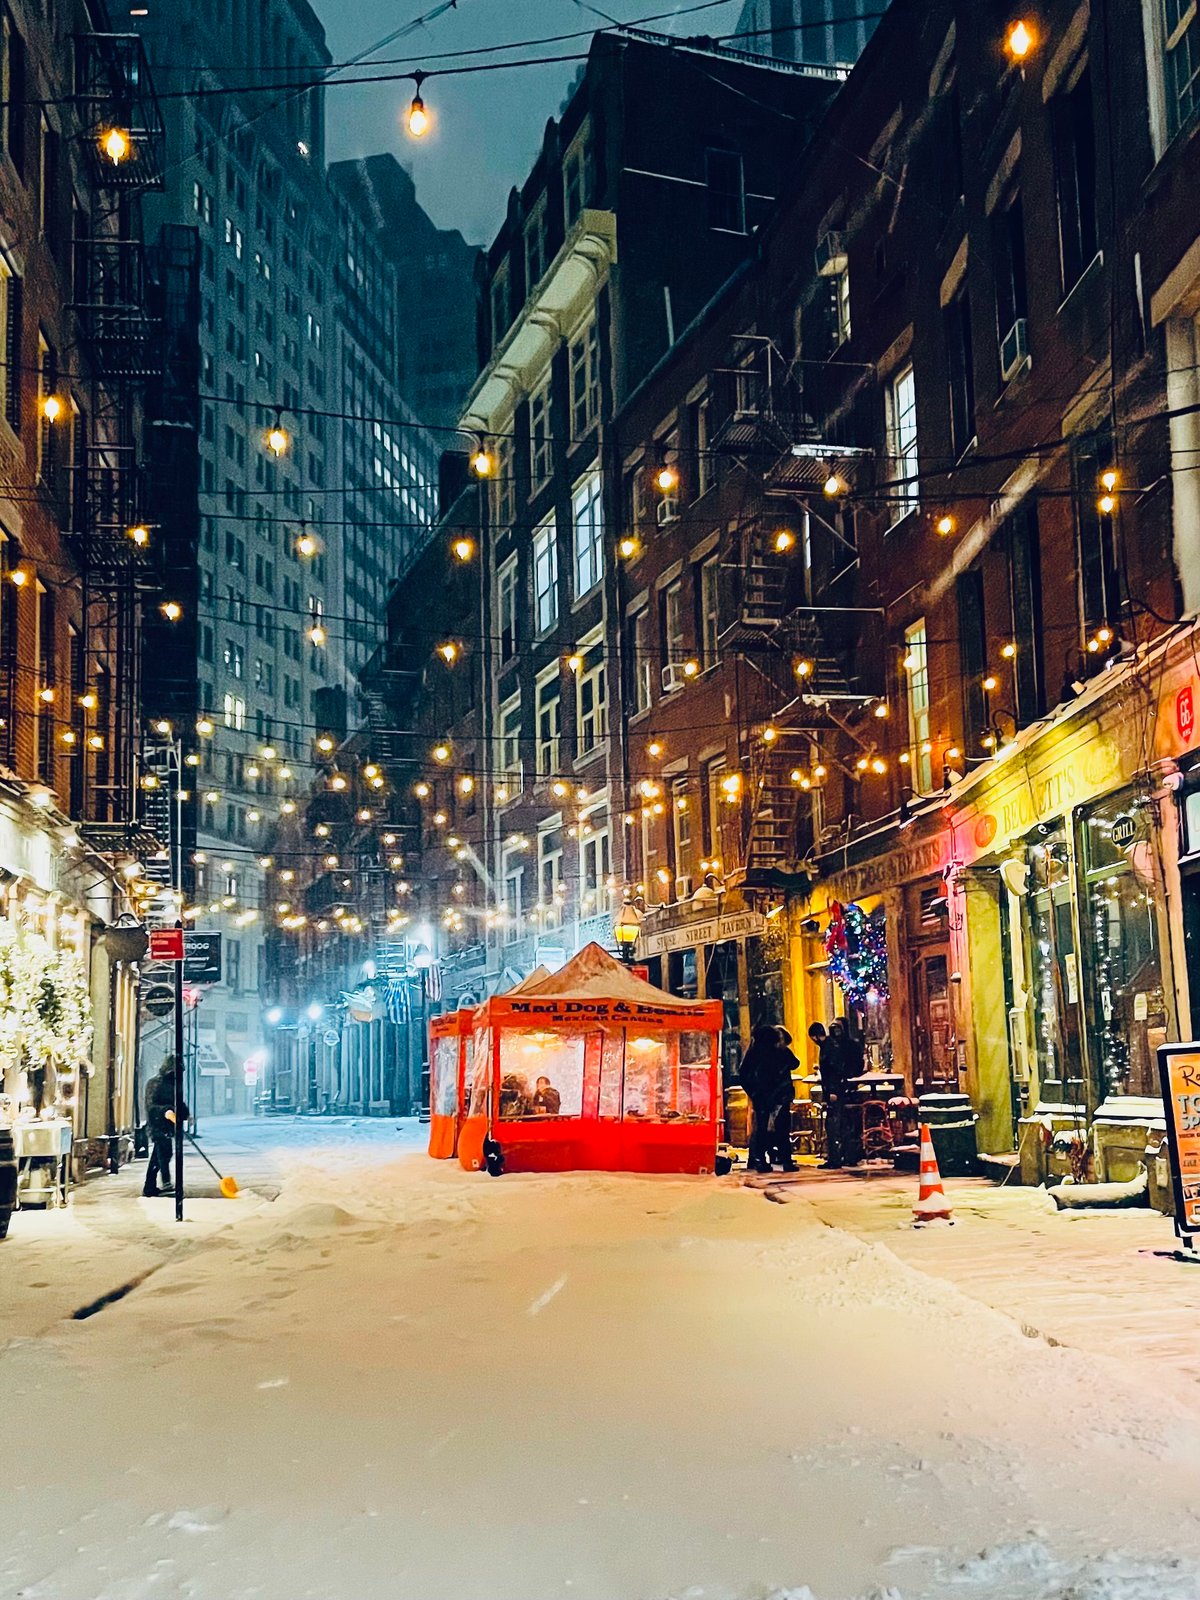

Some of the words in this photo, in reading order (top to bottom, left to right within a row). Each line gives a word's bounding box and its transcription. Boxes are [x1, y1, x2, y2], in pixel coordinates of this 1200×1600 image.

[1112, 821, 1134, 842] GRILL
[686, 926, 712, 941] STREET
[721, 916, 752, 935] TAVERN
[511, 1002, 558, 1013] Mad
[565, 1002, 609, 1014] Dog
[613, 1002, 631, 1013] &
[552, 1014, 608, 1022] Mexican
[611, 1014, 663, 1024] Cantina
